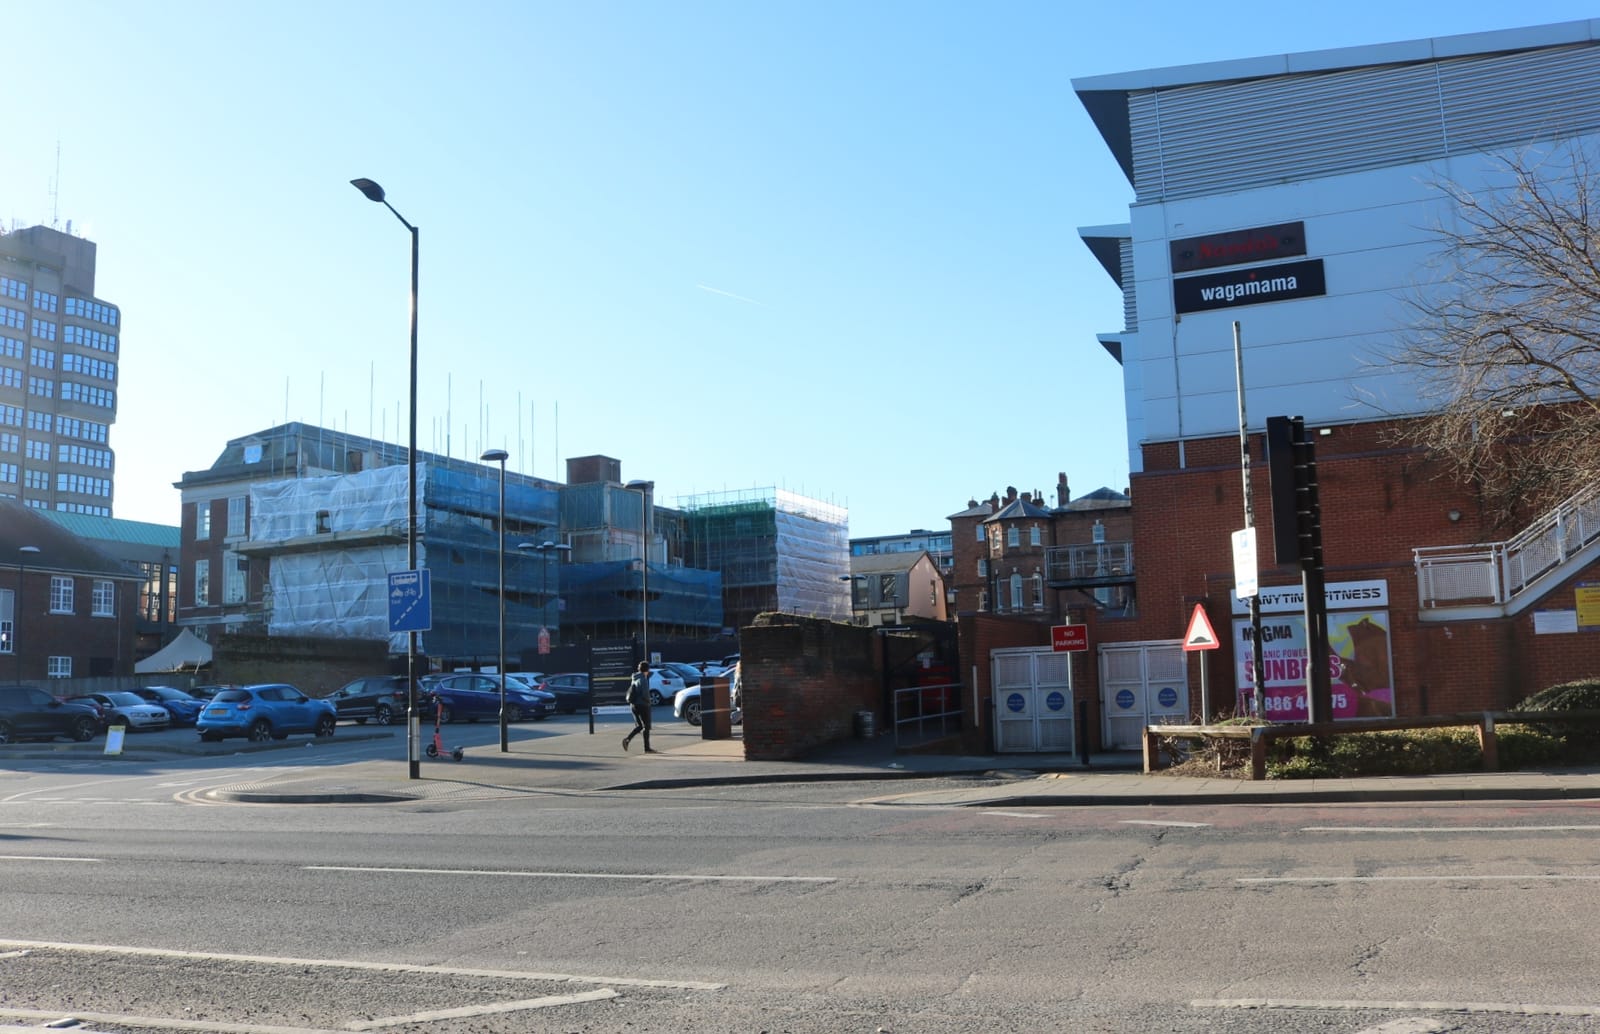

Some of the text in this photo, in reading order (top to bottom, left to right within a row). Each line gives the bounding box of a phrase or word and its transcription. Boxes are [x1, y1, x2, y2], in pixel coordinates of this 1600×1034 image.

[1201, 276, 1297, 301] wagamama
[1257, 592, 1304, 605] NYTI
[1242, 625, 1292, 642] MGMA
[1244, 649, 1280, 659] VANIC
[1244, 655, 1341, 682] SUNBS
[1248, 693, 1347, 712] 0886 475
